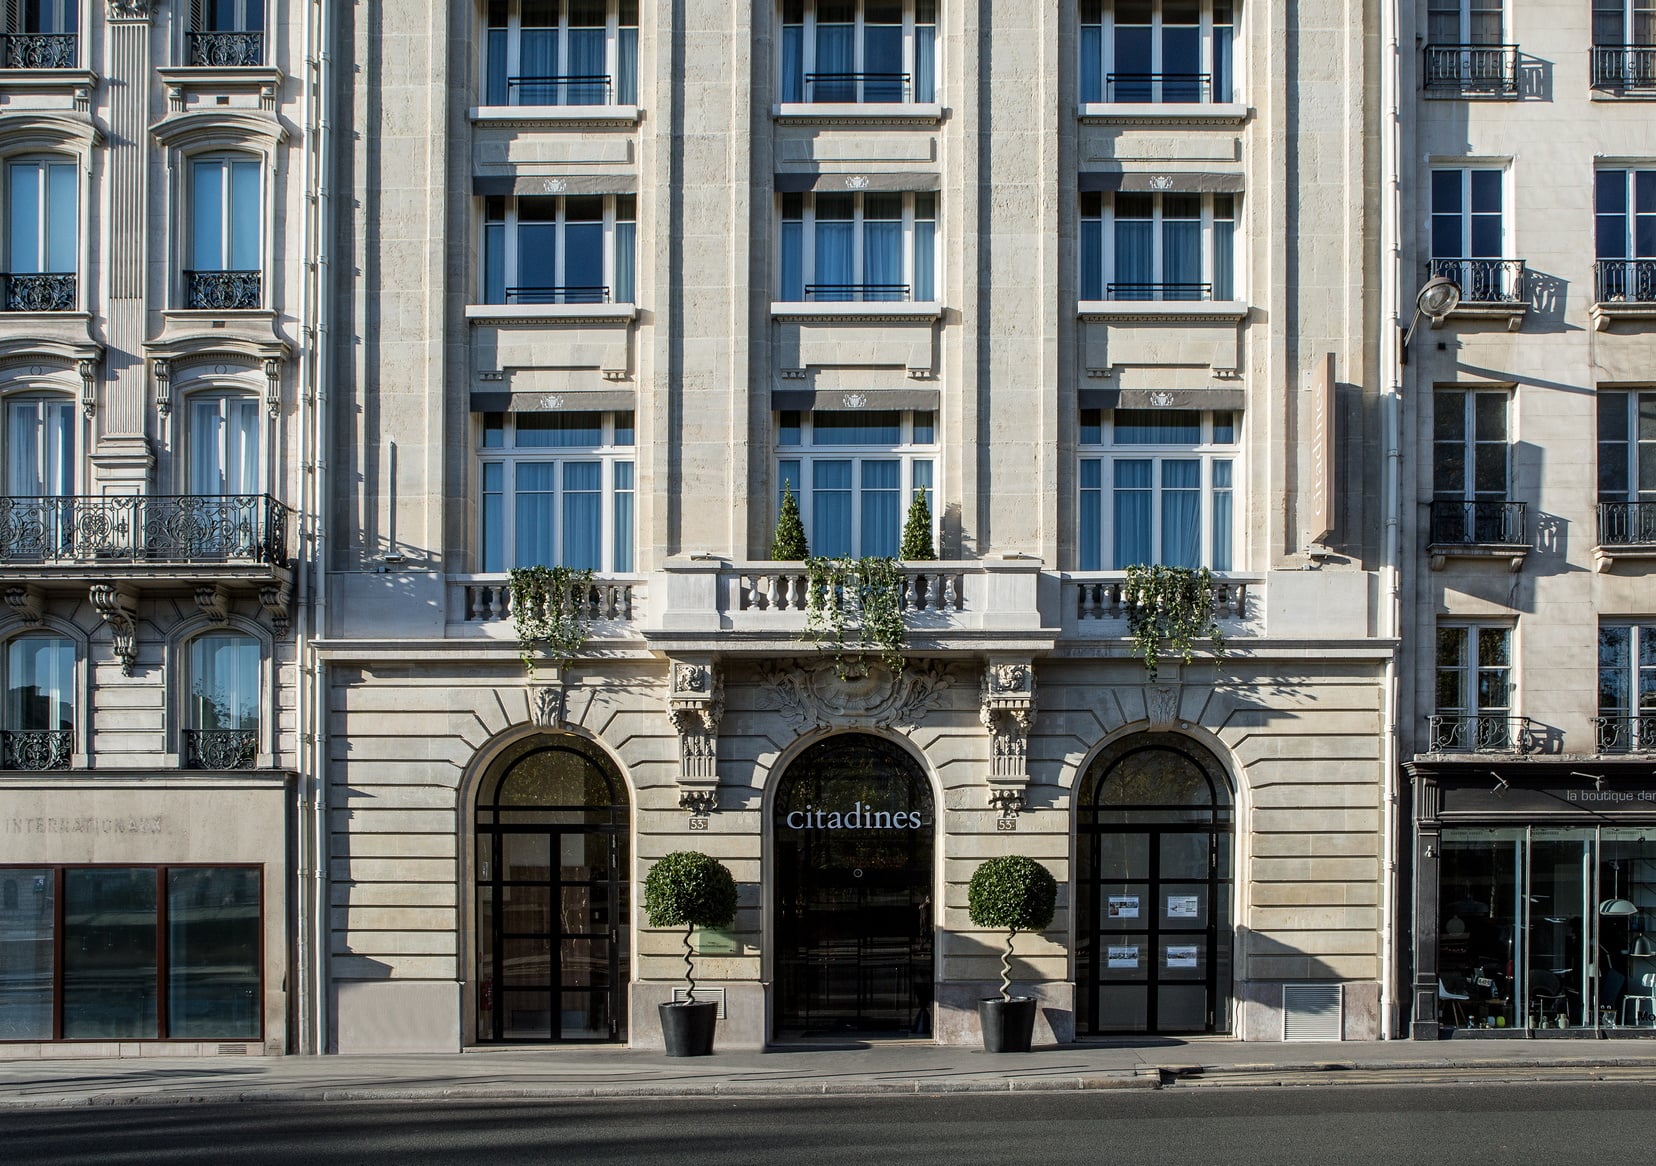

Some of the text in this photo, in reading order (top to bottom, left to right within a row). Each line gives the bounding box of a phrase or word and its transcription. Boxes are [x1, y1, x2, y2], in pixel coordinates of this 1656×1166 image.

[1312, 383, 1323, 516] citadines
[1566, 790, 1577, 801] la
[1581, 790, 1634, 804] boutique
[786, 801, 922, 829] citadines
